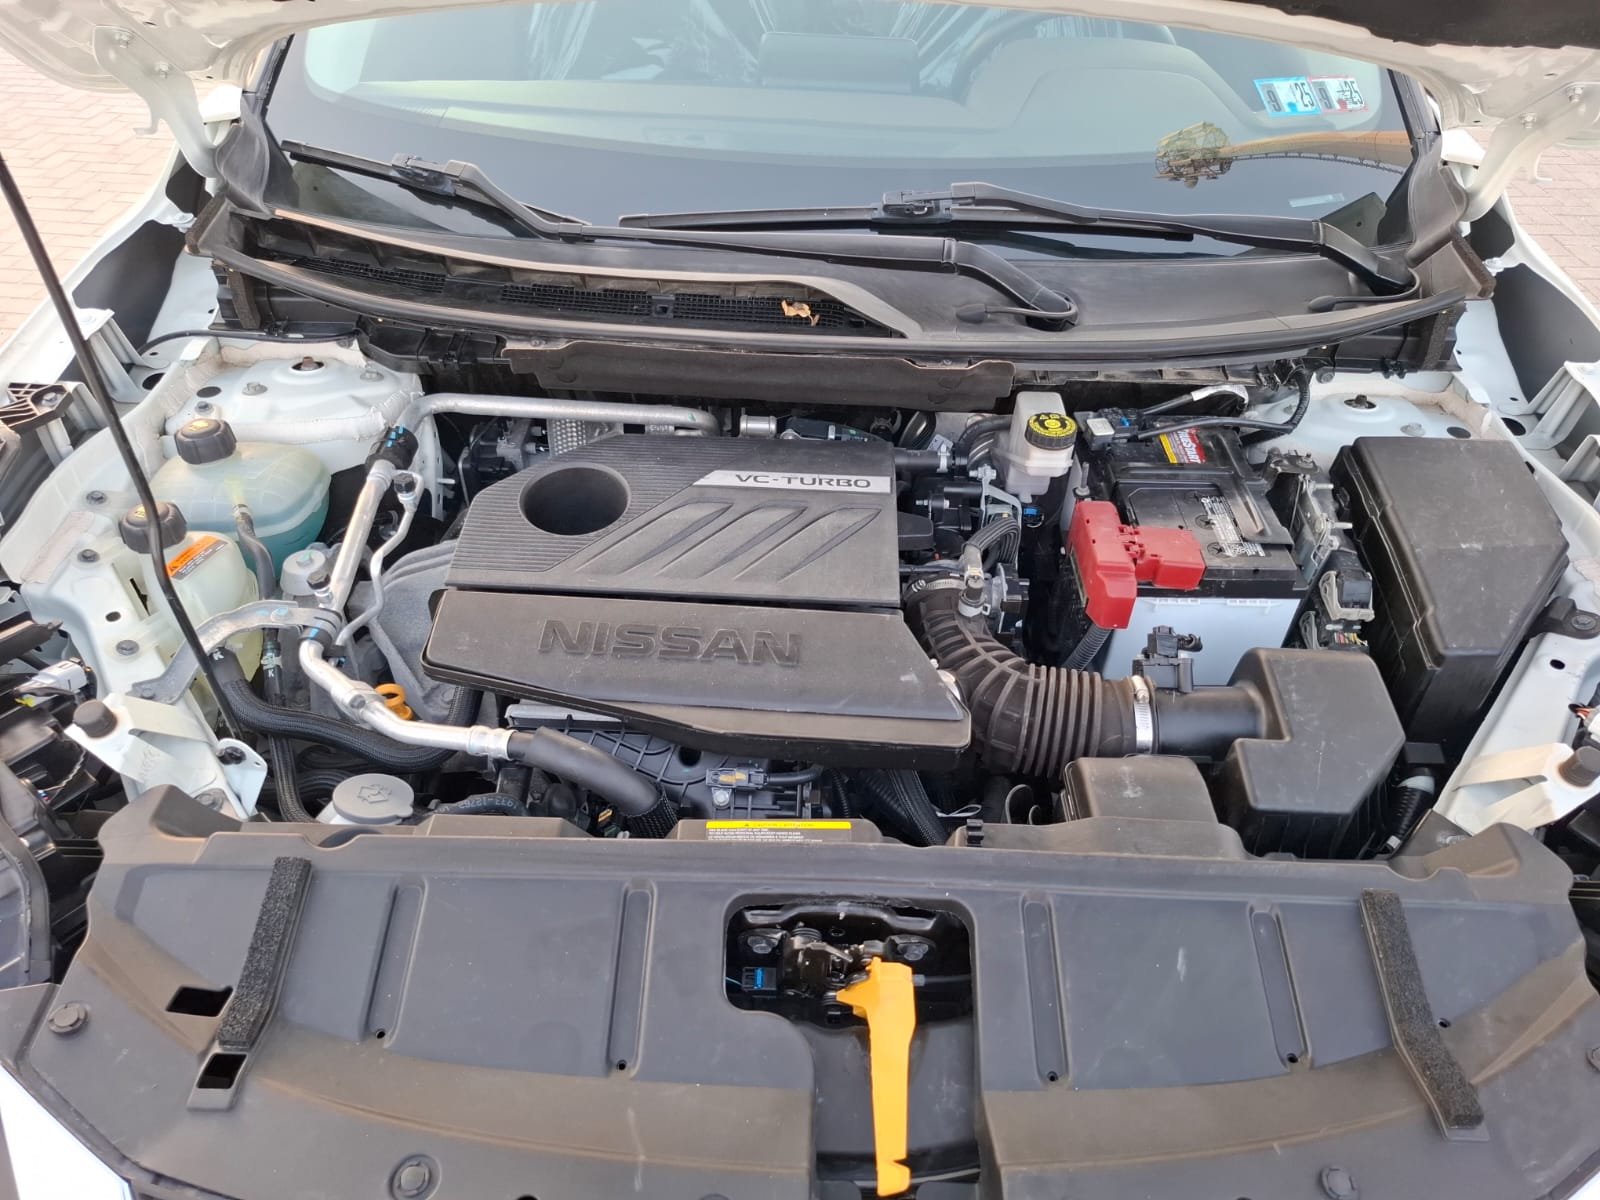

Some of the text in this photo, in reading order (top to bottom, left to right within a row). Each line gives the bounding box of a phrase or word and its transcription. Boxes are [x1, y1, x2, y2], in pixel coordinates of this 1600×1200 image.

[1266, 82, 1314, 112] 9 25
[1318, 87, 1332, 109] 9
[735, 474, 871, 488] VC-TURBO
[537, 619, 802, 667] NISSAN
